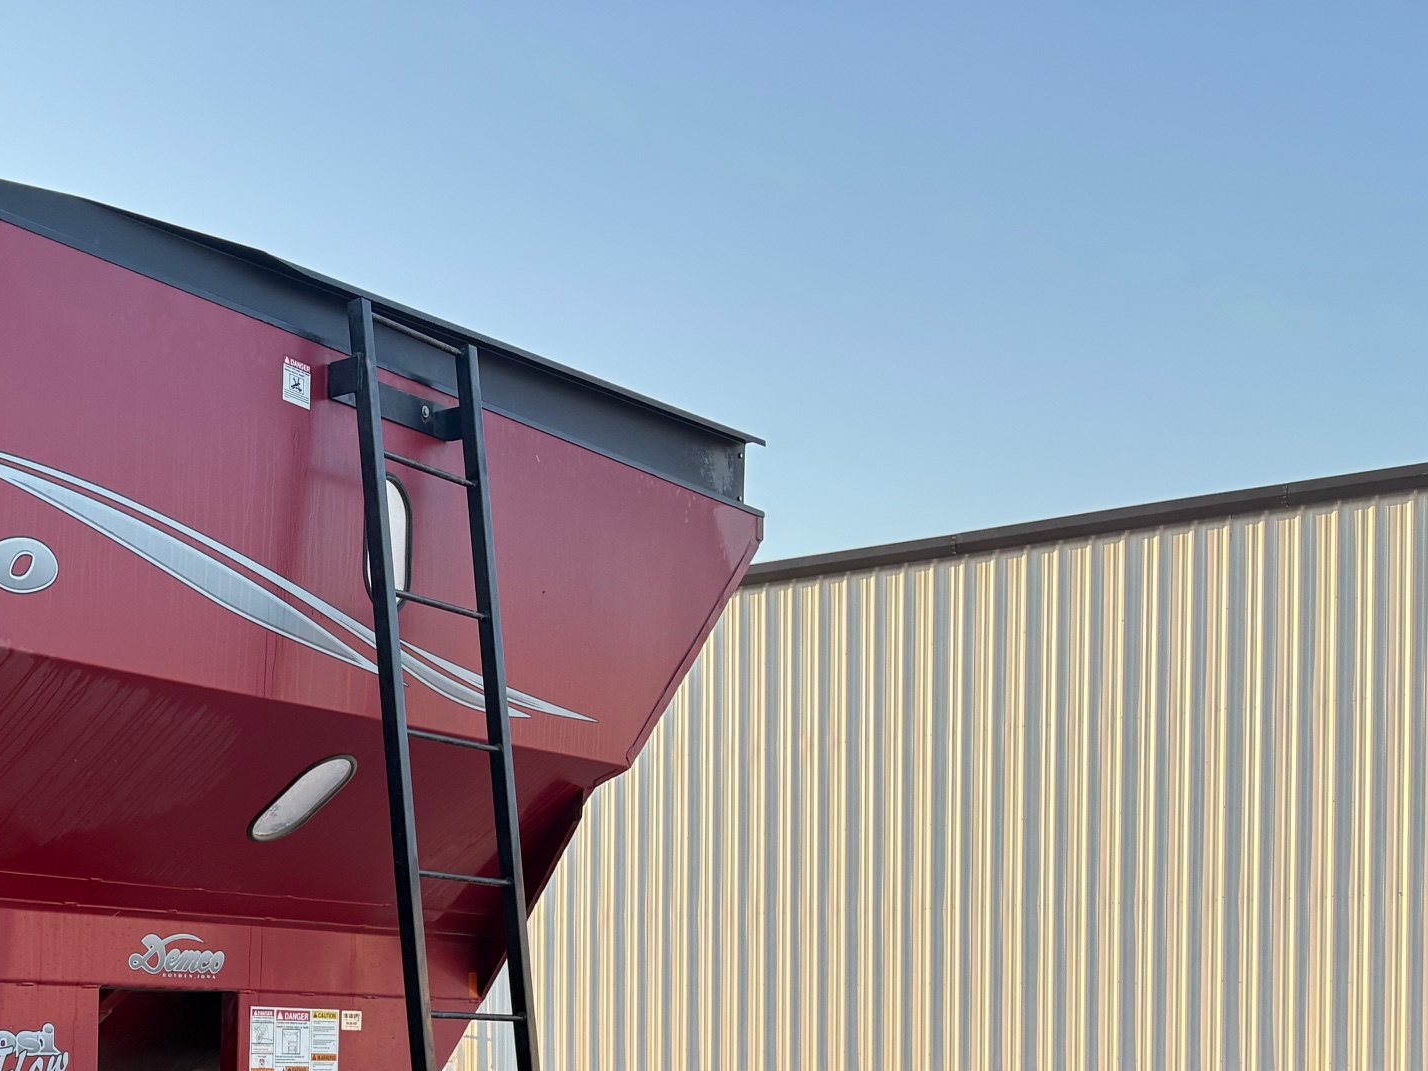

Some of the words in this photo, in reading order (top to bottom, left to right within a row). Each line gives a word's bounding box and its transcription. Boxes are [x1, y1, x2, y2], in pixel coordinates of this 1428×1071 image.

[290, 358, 311, 372] DANGER
[128, 933, 225, 974] Demco
[284, 1012, 309, 1021] DANGER
